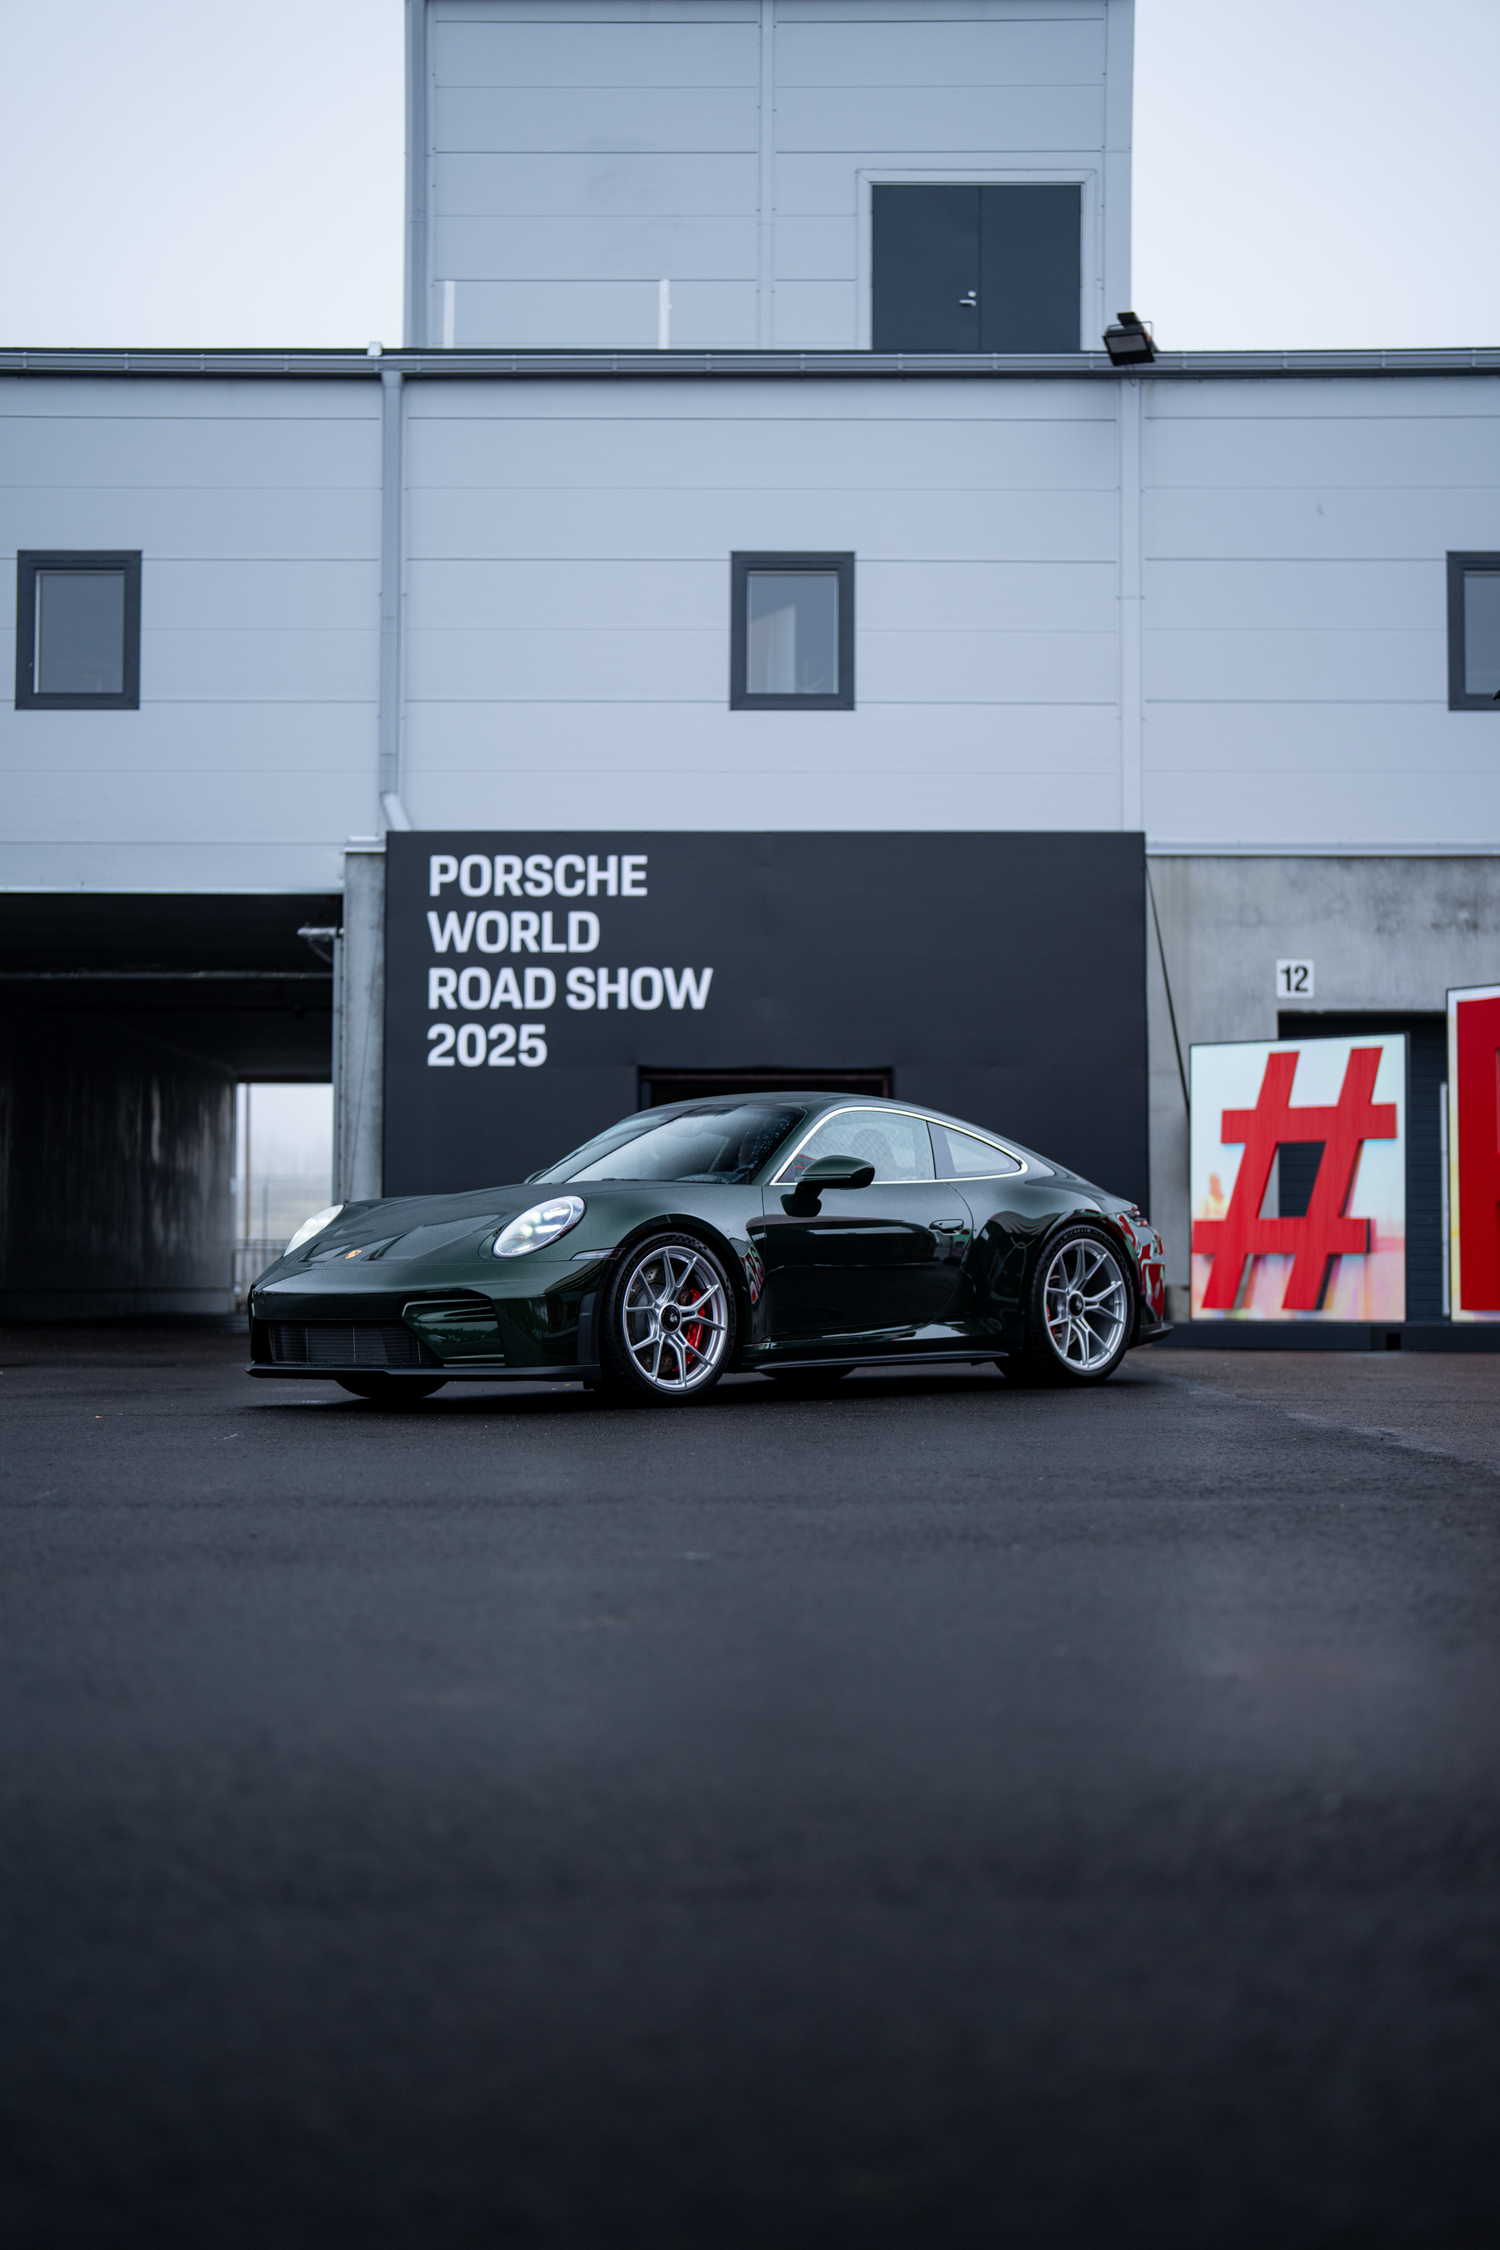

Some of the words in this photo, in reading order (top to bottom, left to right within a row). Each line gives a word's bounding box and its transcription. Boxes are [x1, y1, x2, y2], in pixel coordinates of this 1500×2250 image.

[429, 854, 649, 898] PORSCHE
[426, 910, 601, 954] WORLD
[428, 966, 557, 1011] ROAD
[565, 966, 714, 1011] SHOW
[1280, 965, 1310, 993] 12
[426, 1023, 548, 1068] 2025
[616, 1256, 637, 1298] MICHELIN
